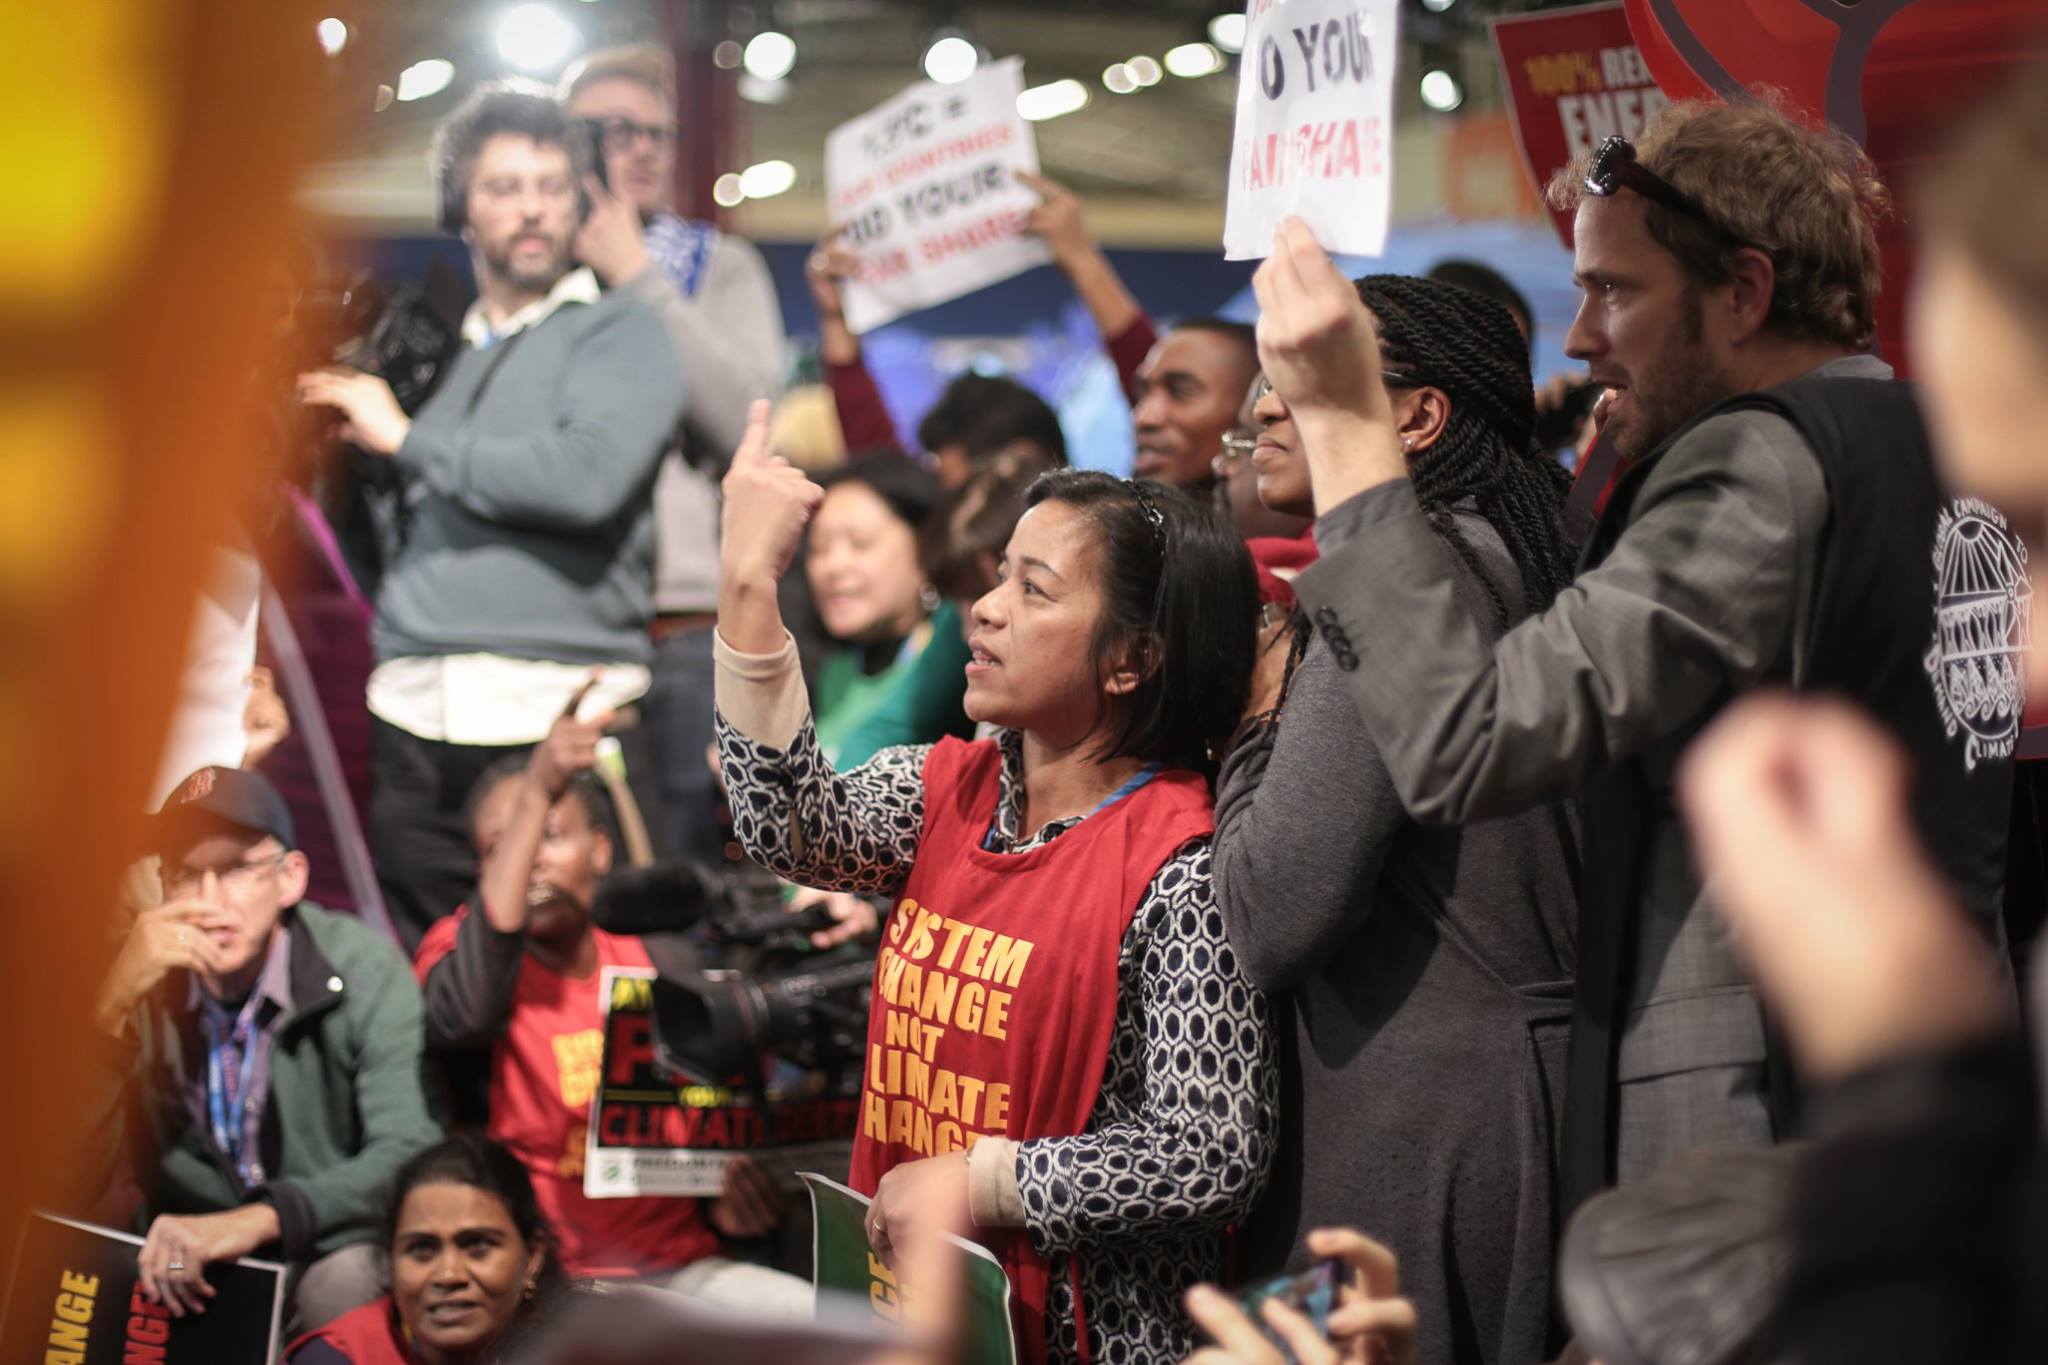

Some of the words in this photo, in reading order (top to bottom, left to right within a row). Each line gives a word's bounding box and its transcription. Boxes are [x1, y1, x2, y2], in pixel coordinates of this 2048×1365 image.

[1298, 115, 1382, 178] SHAE
[897, 160, 1004, 224] YOUR
[2015, 534, 2028, 564] TO
[885, 1010, 945, 1063] NOT
